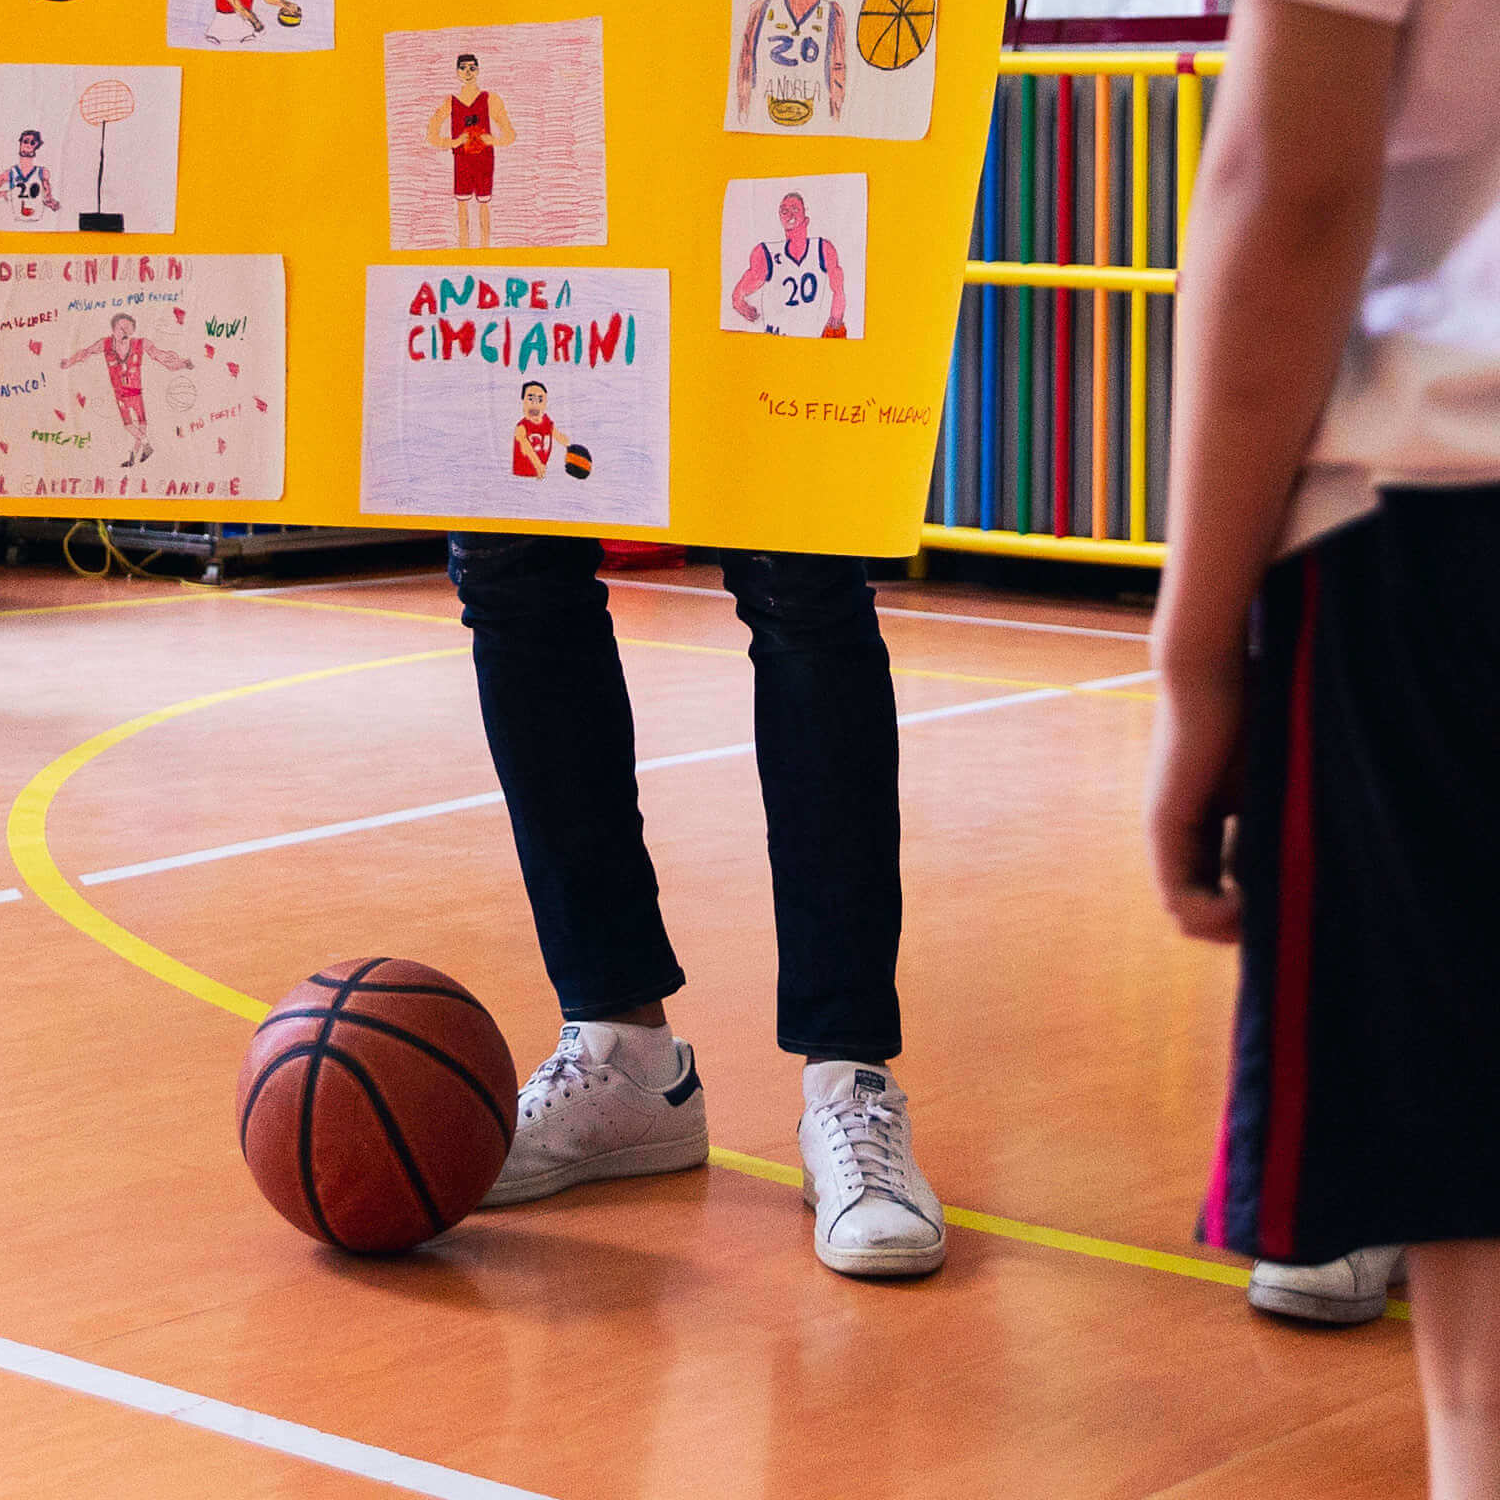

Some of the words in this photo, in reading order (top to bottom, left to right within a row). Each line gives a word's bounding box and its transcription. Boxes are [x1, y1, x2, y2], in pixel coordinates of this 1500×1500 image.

[767, 35, 820, 67] 20
[765, 75, 821, 101] ANDREA
[16, 182, 40, 199] 20
[409, 275, 571, 315] ANDREA
[782, 272, 818, 306] 20
[205, 315, 248, 341] WOW!
[409, 312, 635, 374] CINCIARINI
[879, 406, 931, 426] MILANO
